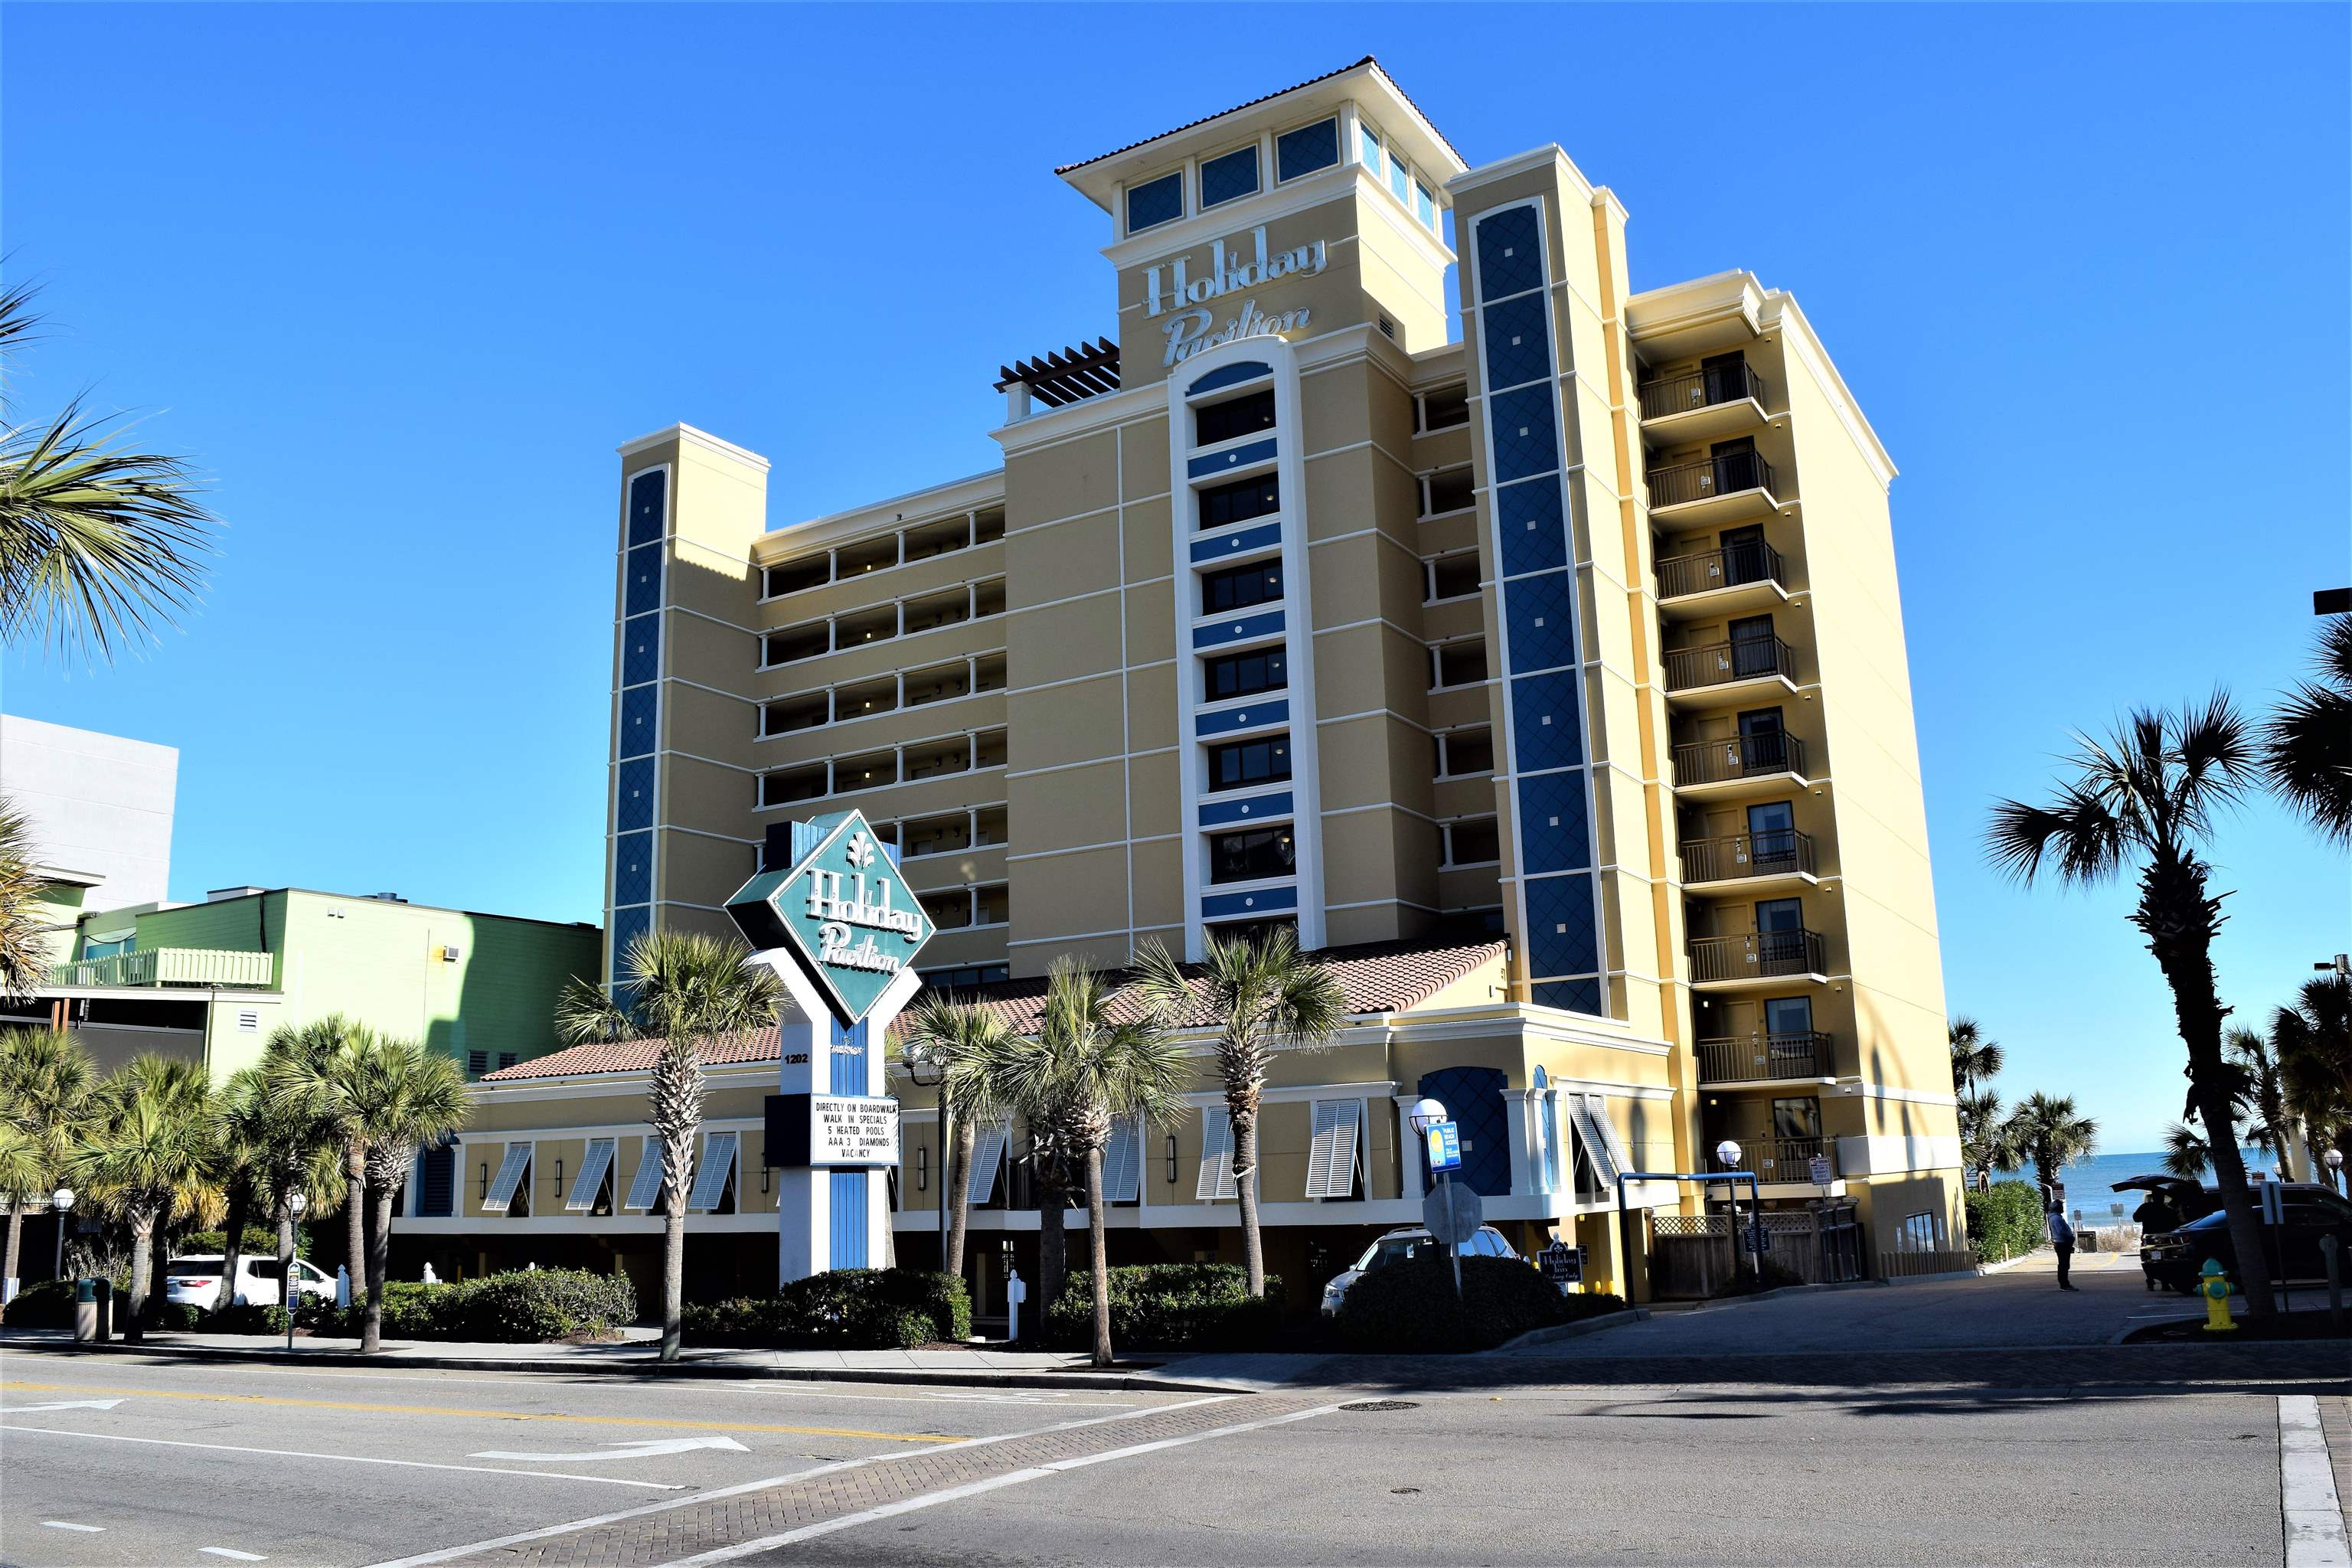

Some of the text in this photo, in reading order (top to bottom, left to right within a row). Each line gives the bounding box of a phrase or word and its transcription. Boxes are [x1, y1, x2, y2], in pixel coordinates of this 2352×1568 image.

[1142, 225, 1328, 318] Holiday
[1162, 299, 1310, 368] Pavilion
[806, 867, 923, 942] Holiday
[818, 921, 900, 973] Pavilion
[784, 1053, 808, 1064] 1202
[815, 1102, 897, 1114] DIRECTLY ON BOARDWALK
[823, 1114, 887, 1125] WALK IN SPECIALS
[828, 1125, 885, 1135] 5 HEATED POOLS
[828, 1137, 890, 1147] AAA 3 DIAMONDS
[841, 1149, 871, 1158] VACANCY
[1544, 1253, 1576, 1266] Holiday
